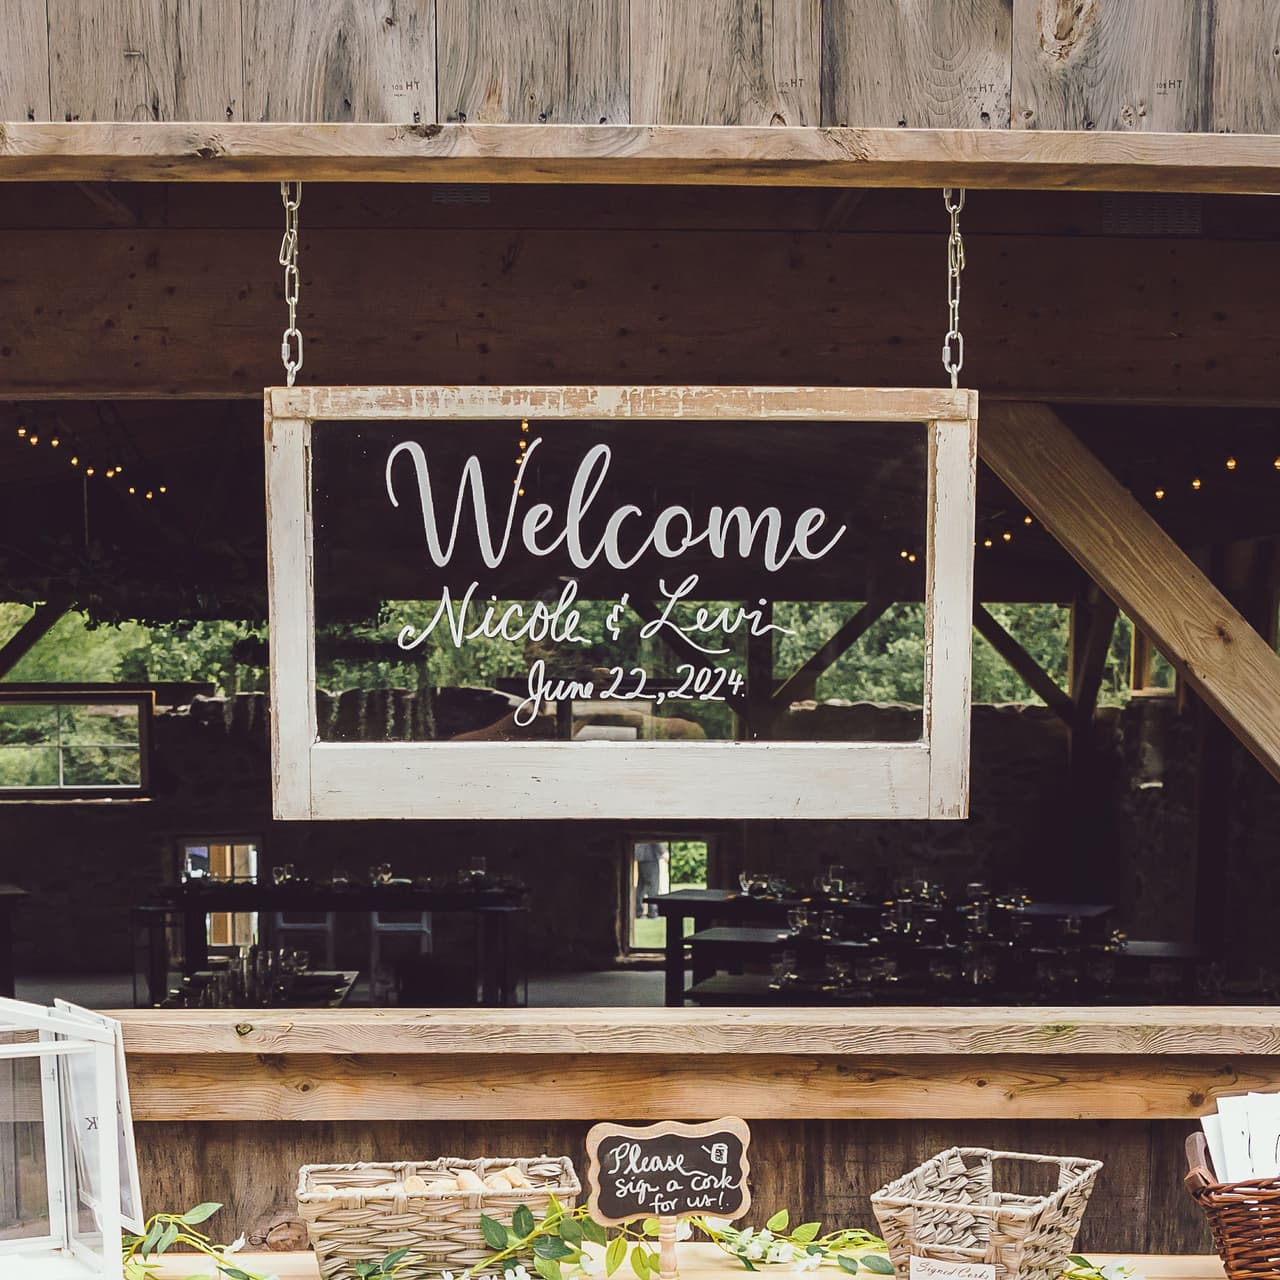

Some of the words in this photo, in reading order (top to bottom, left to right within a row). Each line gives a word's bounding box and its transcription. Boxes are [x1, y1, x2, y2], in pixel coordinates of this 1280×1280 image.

[405, 80, 420, 90] HT
[790, 78, 804, 88] HT
[1168, 79, 1183, 89] HT
[386, 437, 846, 572] Welcome
[397, 580, 591, 650] Nicole
[640, 574, 796, 654] Levi
[514, 660, 594, 726] June
[608, 1142, 707, 1177] Please
[615, 1176, 660, 1204] sign
[666, 1179, 683, 1191] a
[690, 1167, 741, 1192] cork
[649, 1193, 678, 1215] for
[915, 1261, 958, 1277] Signed
